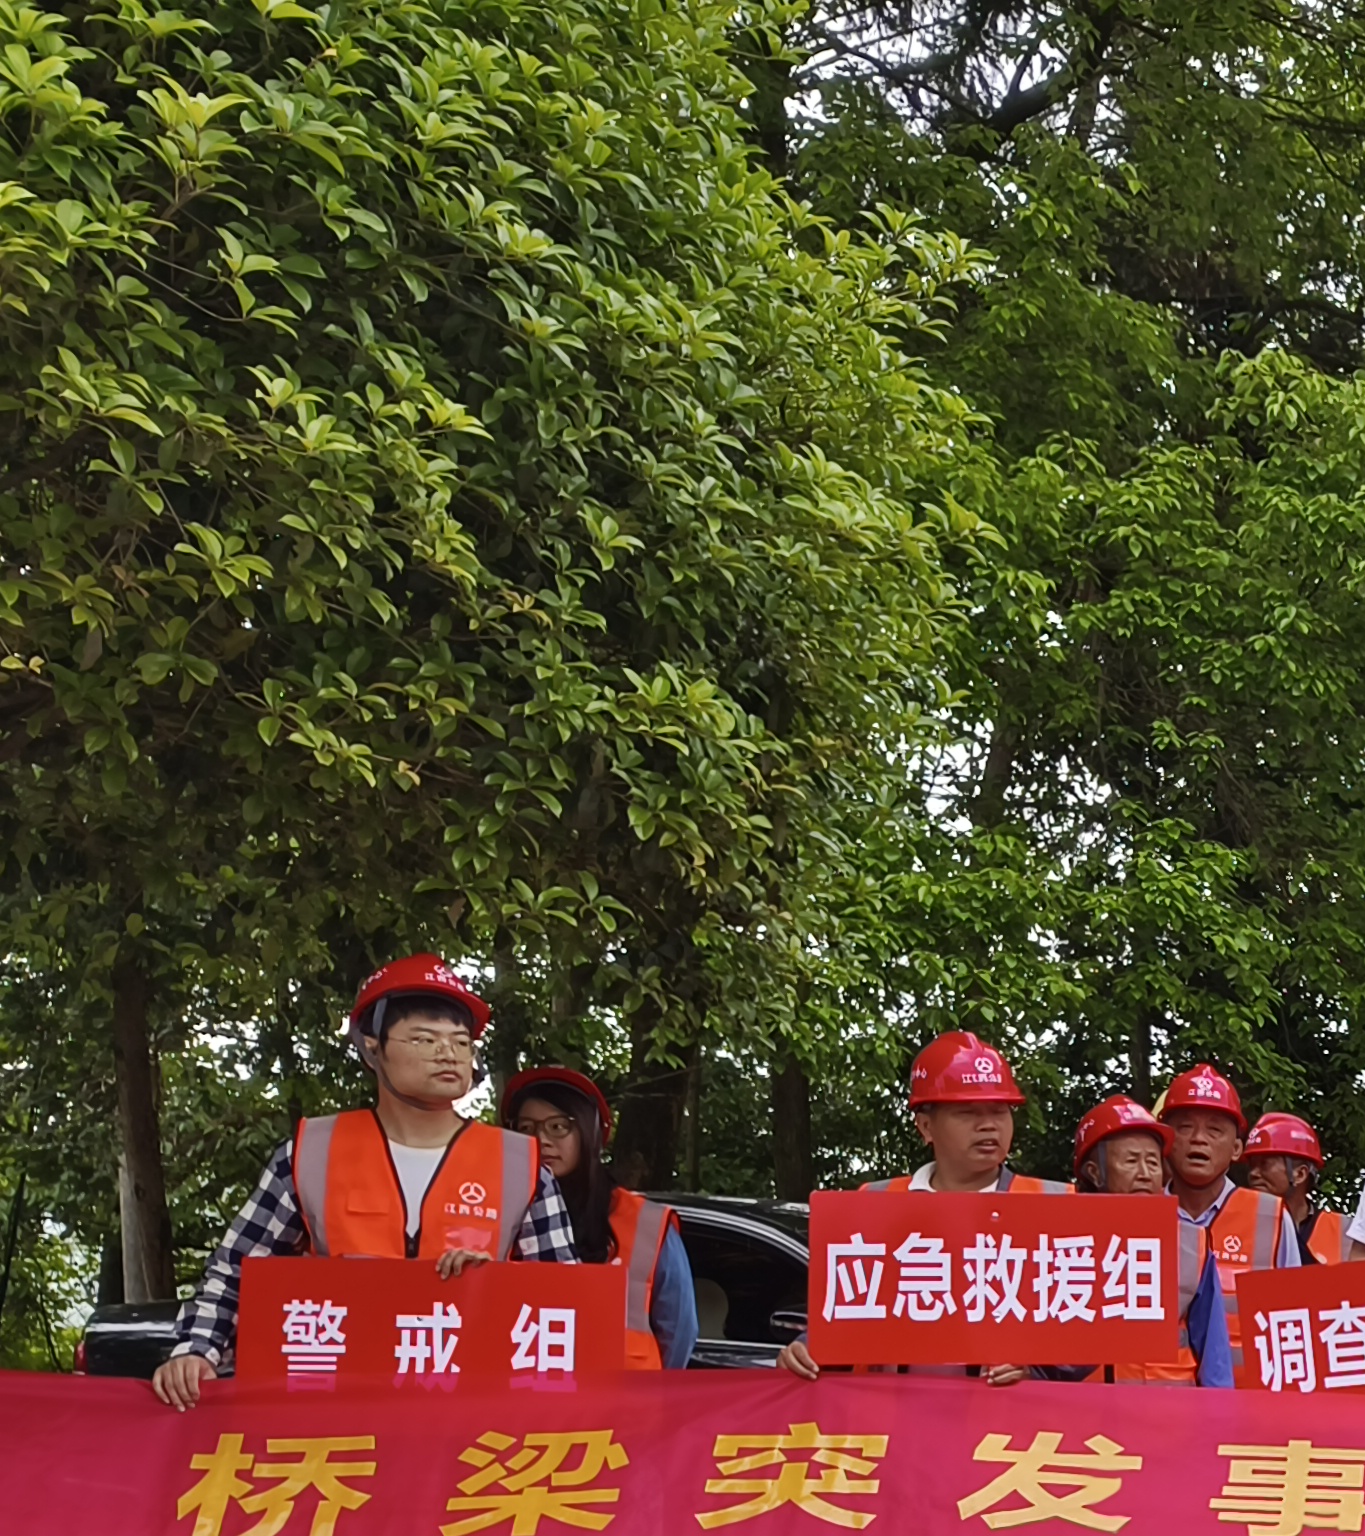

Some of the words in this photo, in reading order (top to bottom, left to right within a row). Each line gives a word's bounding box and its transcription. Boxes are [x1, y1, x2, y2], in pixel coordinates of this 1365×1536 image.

[822, 1232, 1166, 1324] 应急救援组
[281, 1299, 577, 1393] 警戒组
